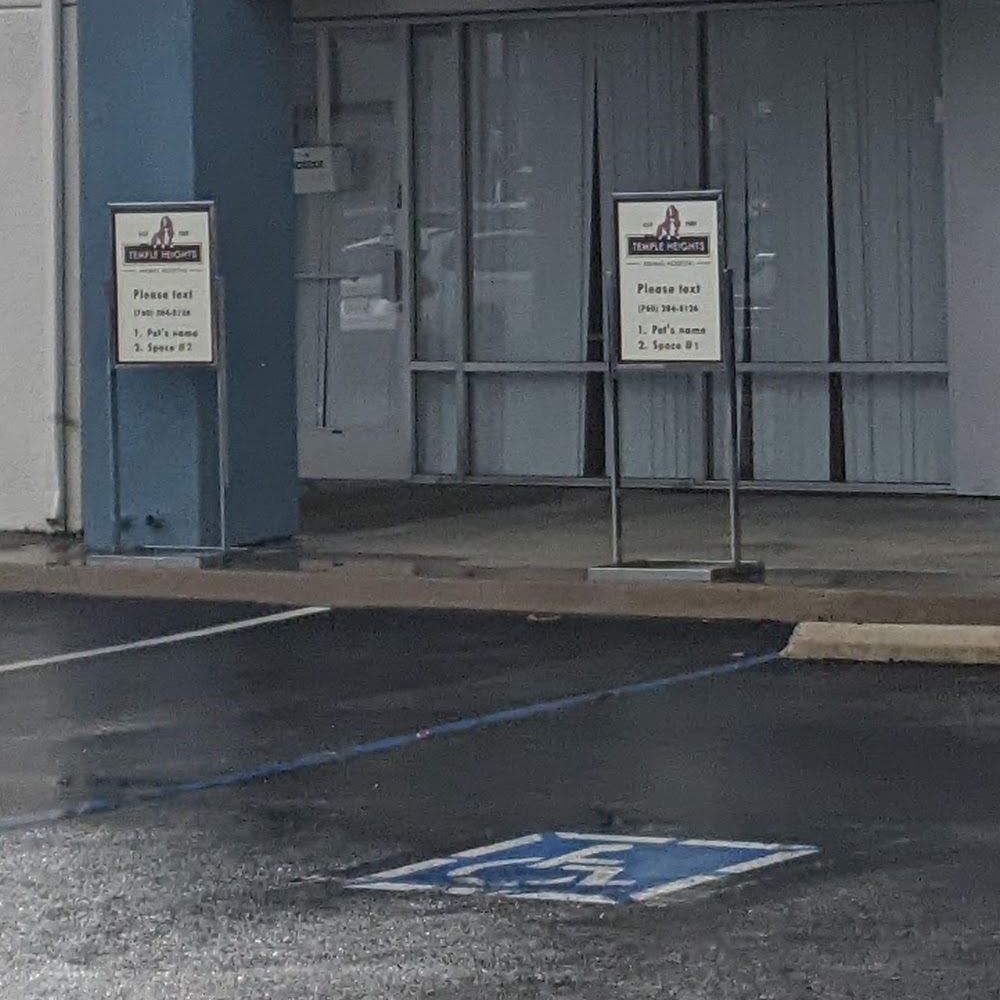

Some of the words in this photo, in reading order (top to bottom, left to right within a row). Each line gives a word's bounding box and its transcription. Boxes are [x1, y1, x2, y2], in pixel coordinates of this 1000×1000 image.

[632, 241, 665, 252] TEMPLE
[667, 240, 705, 251] HEIGHTS
[133, 288, 169, 300] Please
[172, 289, 193, 299] text
[637, 283, 675, 294] Please
[679, 284, 701, 294] text
[147, 328, 169, 337] Pet's
[638, 325, 647, 335] 1.
[651, 324, 675, 335] Pet's
[147, 342, 175, 353] Space
[652, 340, 682, 351] Space
